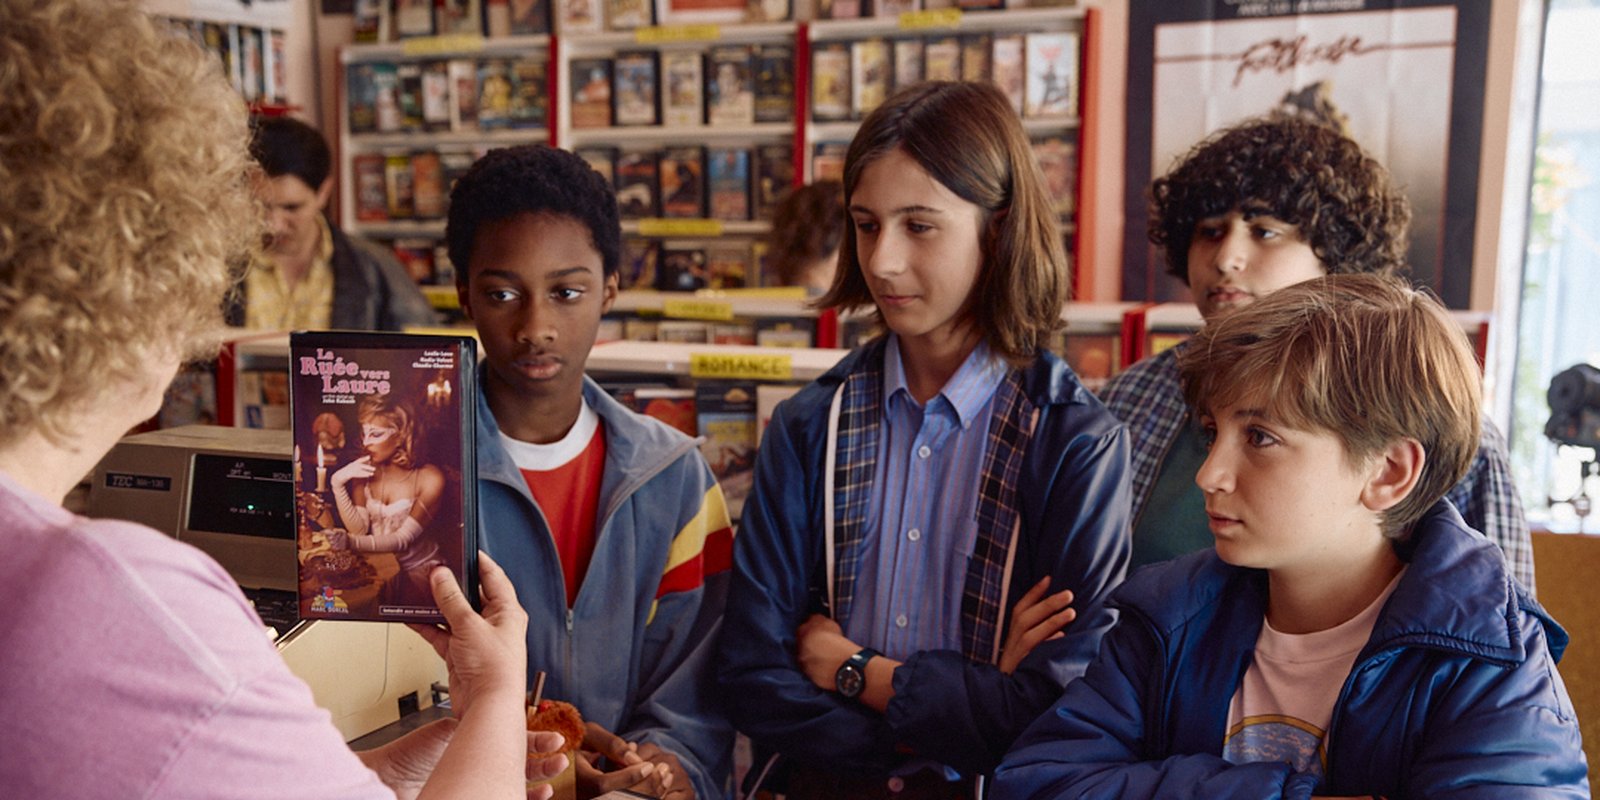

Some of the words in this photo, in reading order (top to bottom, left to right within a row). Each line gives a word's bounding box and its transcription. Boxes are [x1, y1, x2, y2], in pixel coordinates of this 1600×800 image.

[316, 348, 334, 360] La
[300, 357, 359, 376] Ruée
[360, 370, 390, 379] vers
[698, 356, 782, 375] ROMANCE
[322, 375, 391, 394] Laure
[112, 475, 133, 488] TEC
